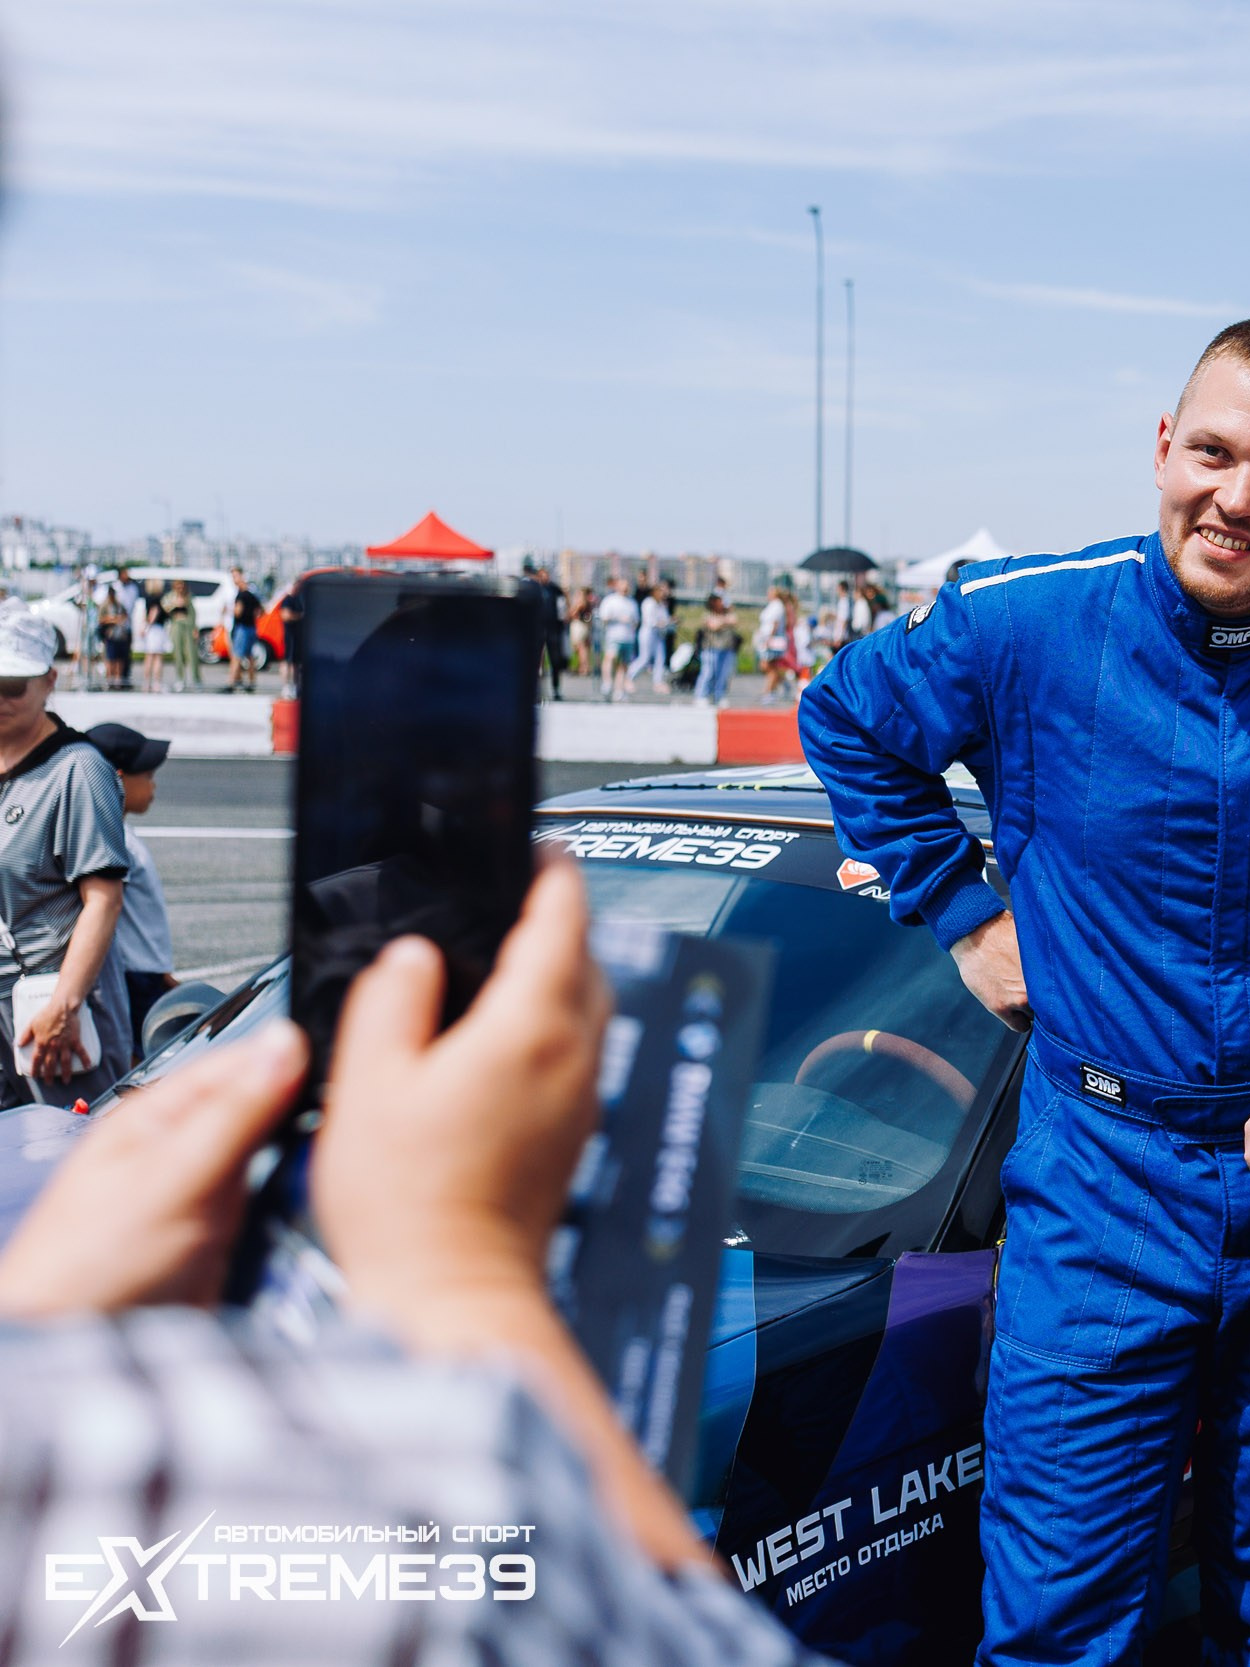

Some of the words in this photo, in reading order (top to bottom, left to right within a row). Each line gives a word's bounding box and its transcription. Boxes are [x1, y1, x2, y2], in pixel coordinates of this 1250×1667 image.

[734, 827, 800, 844] СПОРТ
[1086, 1073, 1121, 1095] OMP
[731, 1497, 852, 1593] WEST
[871, 1442, 984, 1525] LAKE
[786, 1555, 851, 1607] МЕСТО
[857, 1513, 944, 1566] ОТДЫХА
